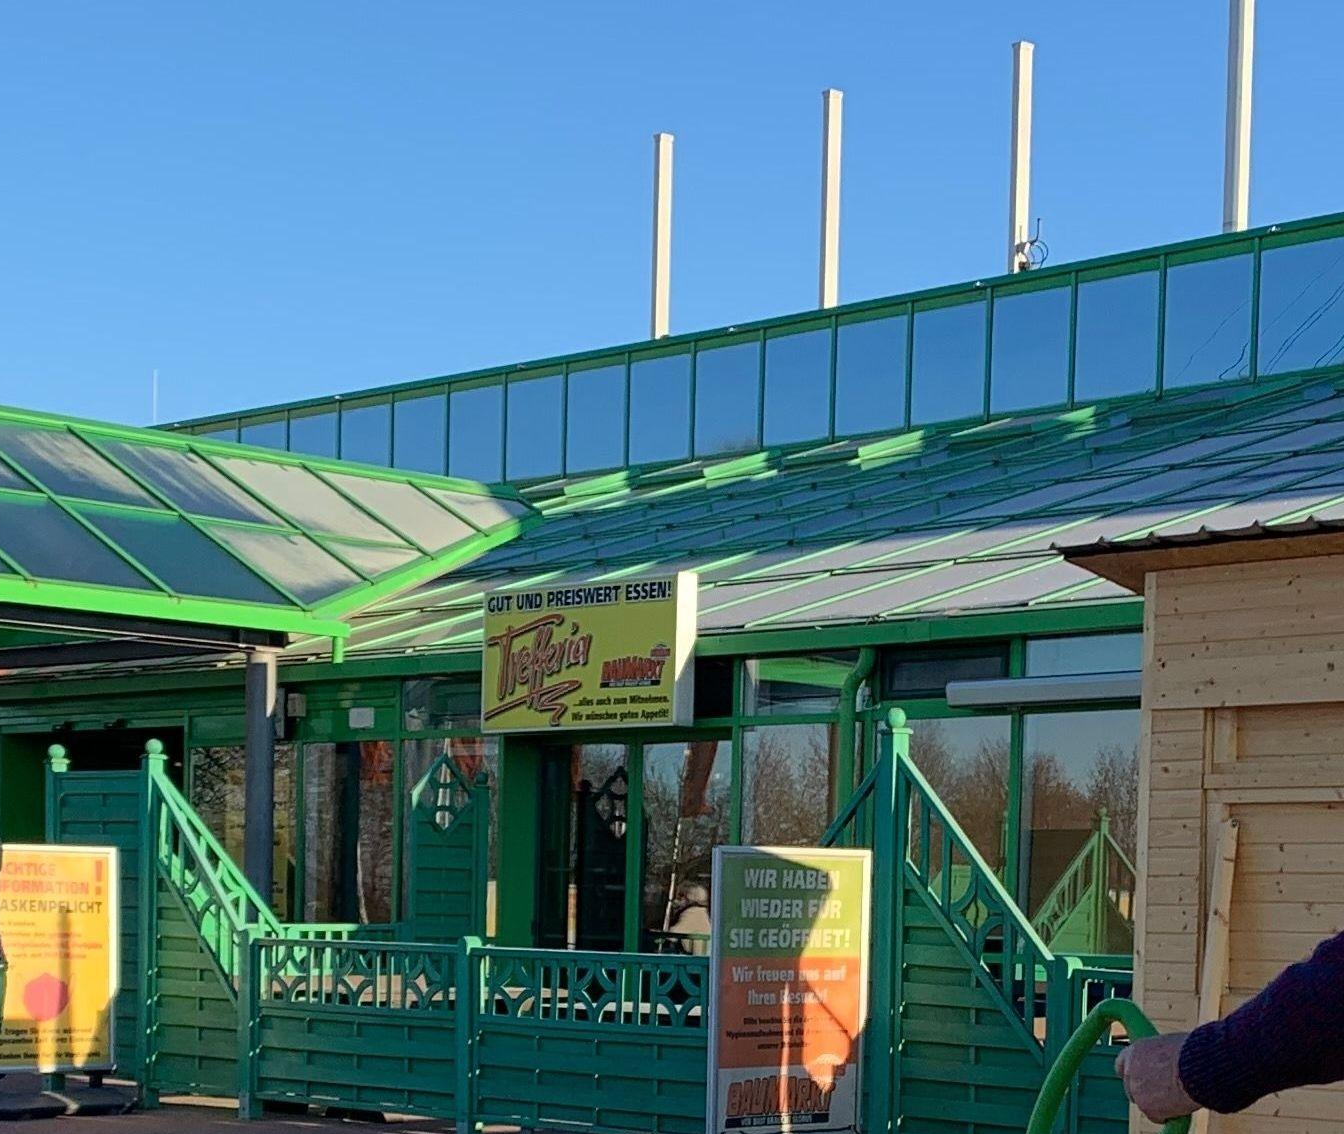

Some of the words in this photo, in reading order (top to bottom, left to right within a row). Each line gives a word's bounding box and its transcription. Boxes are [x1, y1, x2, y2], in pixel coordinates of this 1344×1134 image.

[488, 596, 512, 613] GUT
[517, 592, 542, 610] UND
[547, 585, 621, 607] PREISWERT
[625, 581, 672, 601] ESSEN!
[744, 868, 777, 888] WIR
[782, 869, 841, 890] HABEN
[0, 898, 103, 914] ASKENPFLICHT
[740, 898, 803, 918] WIEDER
[808, 894, 842, 919] FÜR
[729, 928, 754, 948] SIE
[758, 923, 851, 949] GEÖFFNET!
[732, 965, 753, 982] Wir
[757, 965, 795, 982] freuen
[799, 969, 820, 981] uns
[824, 965, 846, 981] auf
[748, 989, 776, 1005] Ihren
[726, 1075, 836, 1118] BAUMARKT
